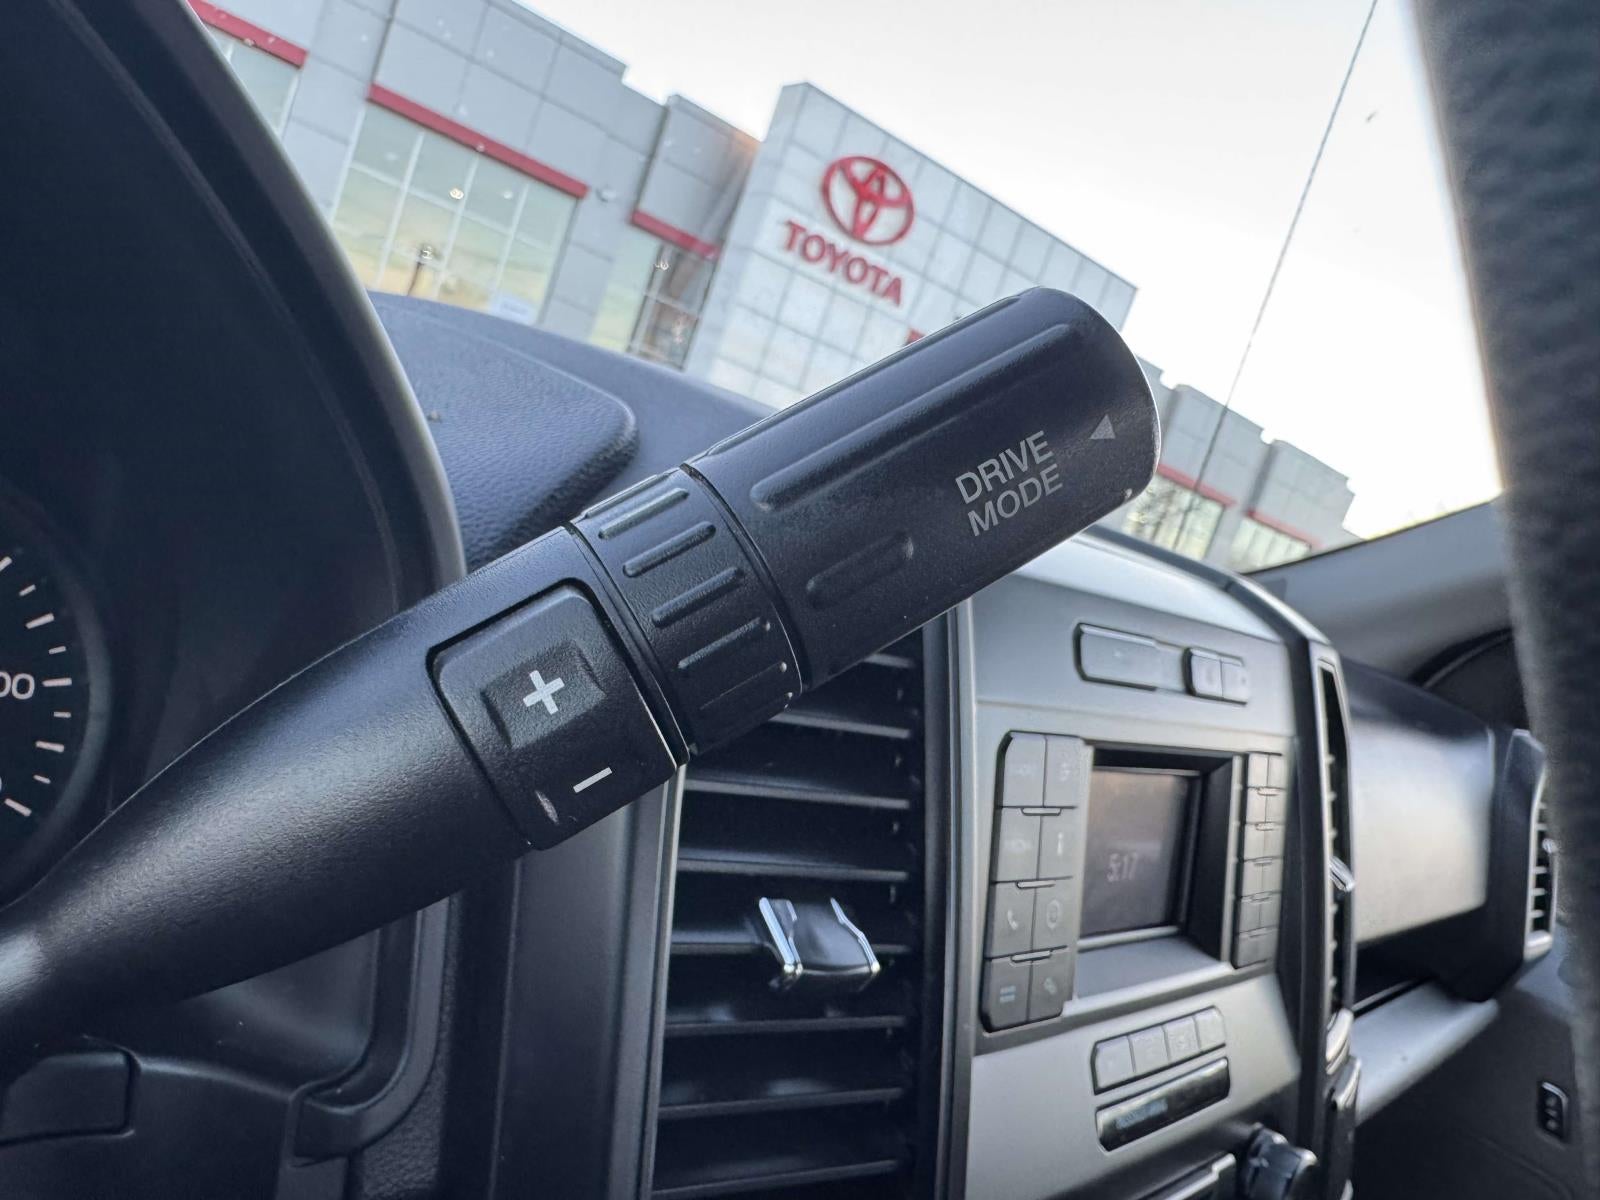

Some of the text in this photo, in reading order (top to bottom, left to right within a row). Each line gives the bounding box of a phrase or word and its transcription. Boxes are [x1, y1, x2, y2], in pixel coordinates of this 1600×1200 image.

[785, 220, 902, 307] TOYOTA
[955, 430, 1054, 504] DRIVE
[967, 463, 1063, 537] MODE
